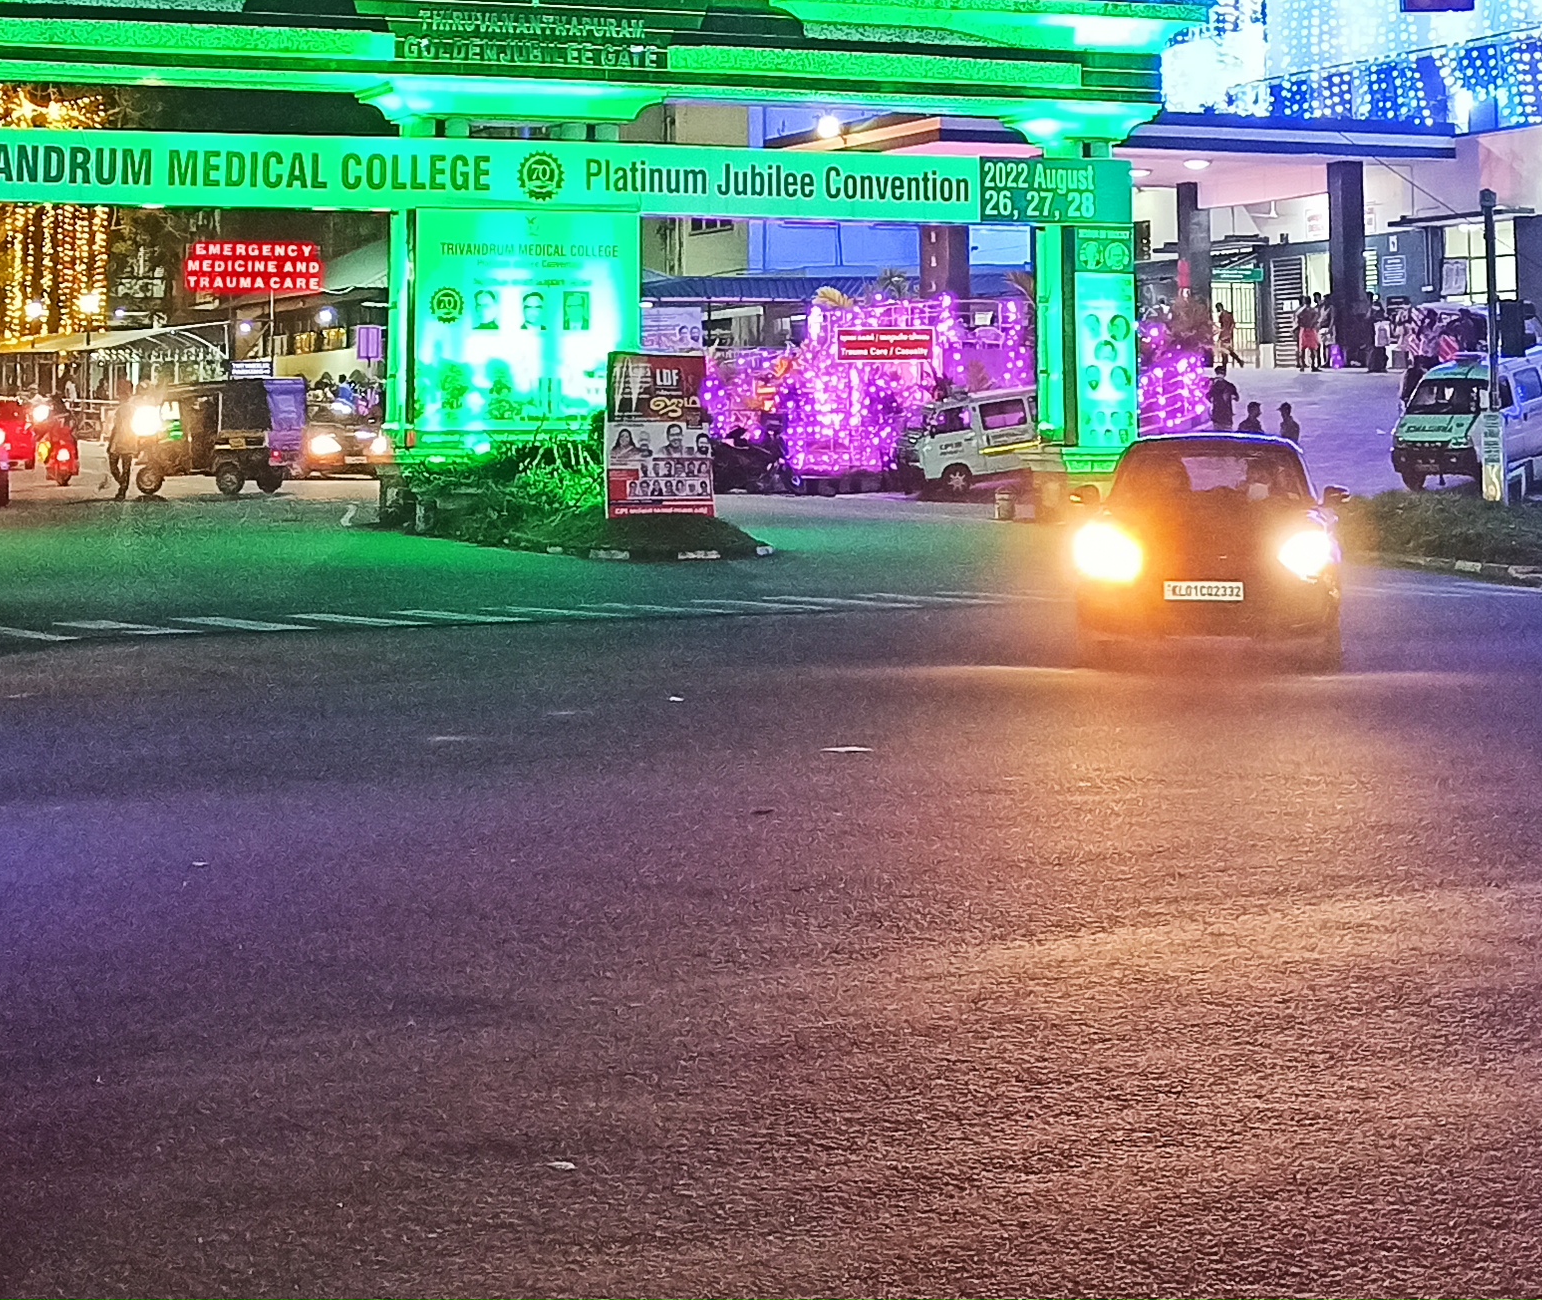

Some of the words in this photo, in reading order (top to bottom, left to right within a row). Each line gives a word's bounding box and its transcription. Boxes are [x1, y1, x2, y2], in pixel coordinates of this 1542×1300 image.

[418, 9, 646, 39] THIRUVANANTHAPURAM
[404, 38, 497, 62] GOLDEN
[498, 42, 594, 66] JUBILEE
[601, 45, 658, 69] GATE
[167, 149, 327, 189] MEDICAL
[341, 153, 491, 192] COLLEGE
[585, 159, 708, 195] Platinum
[716, 163, 815, 199] Jubilee
[825, 167, 970, 203] Convention
[984, 162, 1029, 188] 2022
[1033, 163, 1095, 193] August
[984, 190, 1018, 219] 26,
[1025, 191, 1060, 220] 27,
[1066, 191, 1096, 219] 28
[195, 243, 312, 257] EMERGENCY
[439, 242, 514, 256] TRIVANDRUM
[518, 243, 567, 257] MEDICAL
[570, 245, 619, 258] COLLEGE
[187, 259, 278, 273] MEDICINE
[283, 261, 320, 274] AND
[187, 276, 265, 289] TRAUMA
[269, 277, 320, 290] CARE
[655, 368, 680, 386] LDF
[1171, 584, 1242, 598] KL01CQ2332
